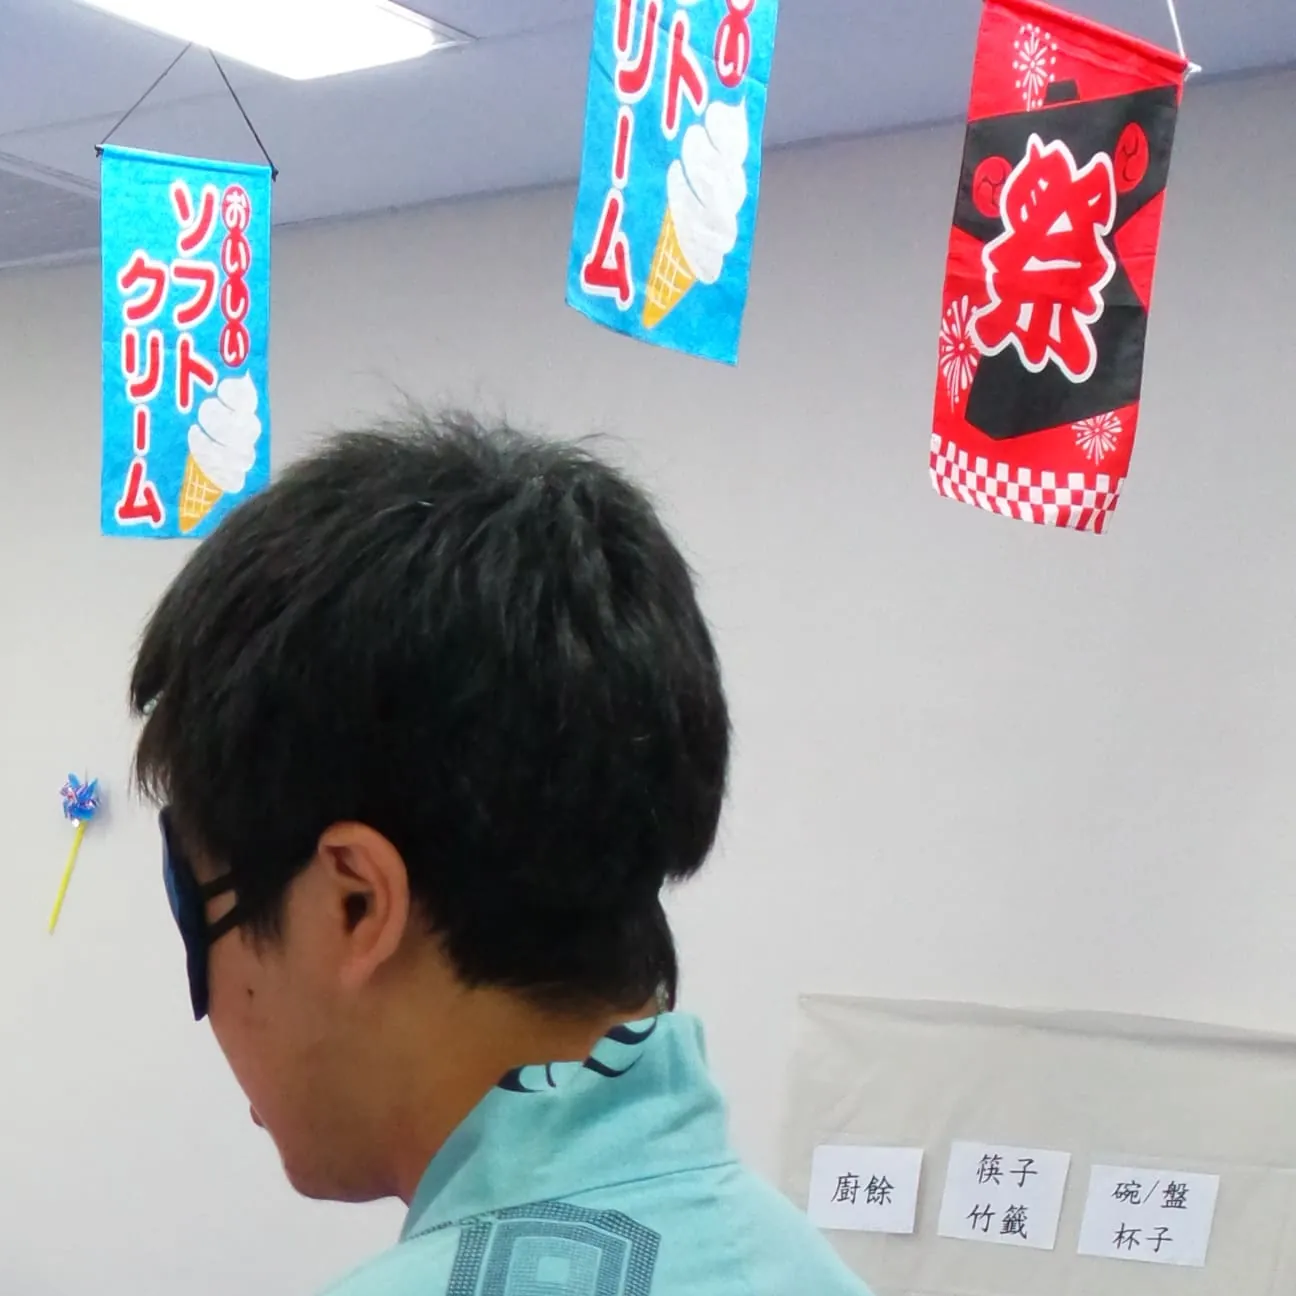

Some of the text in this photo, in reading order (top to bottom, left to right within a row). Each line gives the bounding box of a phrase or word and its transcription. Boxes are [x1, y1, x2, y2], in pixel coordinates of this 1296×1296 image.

[222, 187, 250, 365] おいしい
[970, 131, 1118, 384] 祭
[170, 180, 219, 414] ソフト
[116, 248, 170, 528] クリーム
[830, 1171, 895, 1206] 廚餘
[975, 1152, 1039, 1189] 筷子
[1111, 1179, 1190, 1211] 碗/盤
[966, 1202, 1029, 1240] 竹籤
[1111, 1221, 1174, 1254] 杯子
